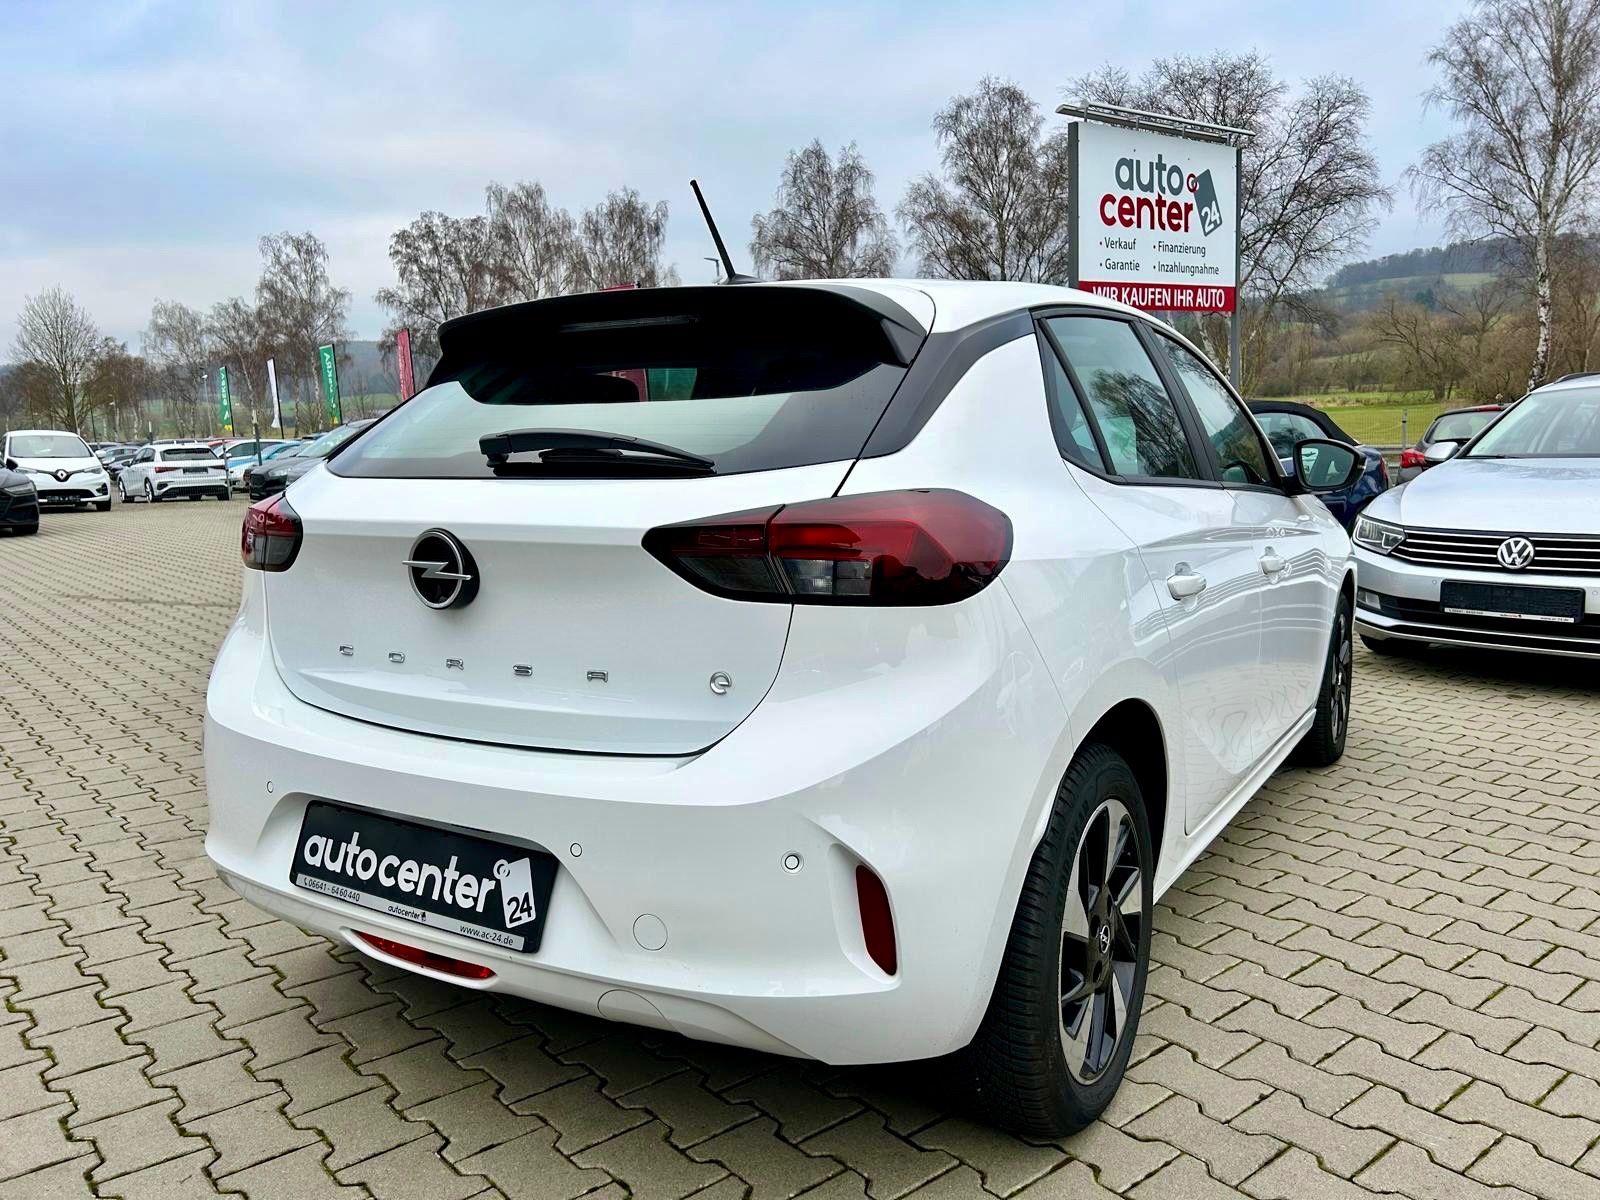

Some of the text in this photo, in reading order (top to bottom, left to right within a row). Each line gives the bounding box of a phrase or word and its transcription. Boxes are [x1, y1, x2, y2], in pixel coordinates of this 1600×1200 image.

[1115, 153, 1184, 195] auto
[1100, 193, 1194, 233] center
[1201, 200, 1220, 232] 24
[1104, 236, 1137, 251] Verkauf
[1158, 241, 1206, 257] Finanzierung
[1105, 258, 1140, 272] Garantie
[1157, 262, 1220, 277] Inzahlungnahme
[1121, 287, 1171, 306] KAUFEN
[1173, 289, 1194, 307] IHR
[1196, 289, 1225, 308] AUTO
[339, 643, 609, 684] CORSA
[304, 832, 495, 912] autocenter
[387, 905, 420, 919] autocenter
[506, 891, 533, 924] 24
[460, 924, 514, 946] www.ac-24.de
